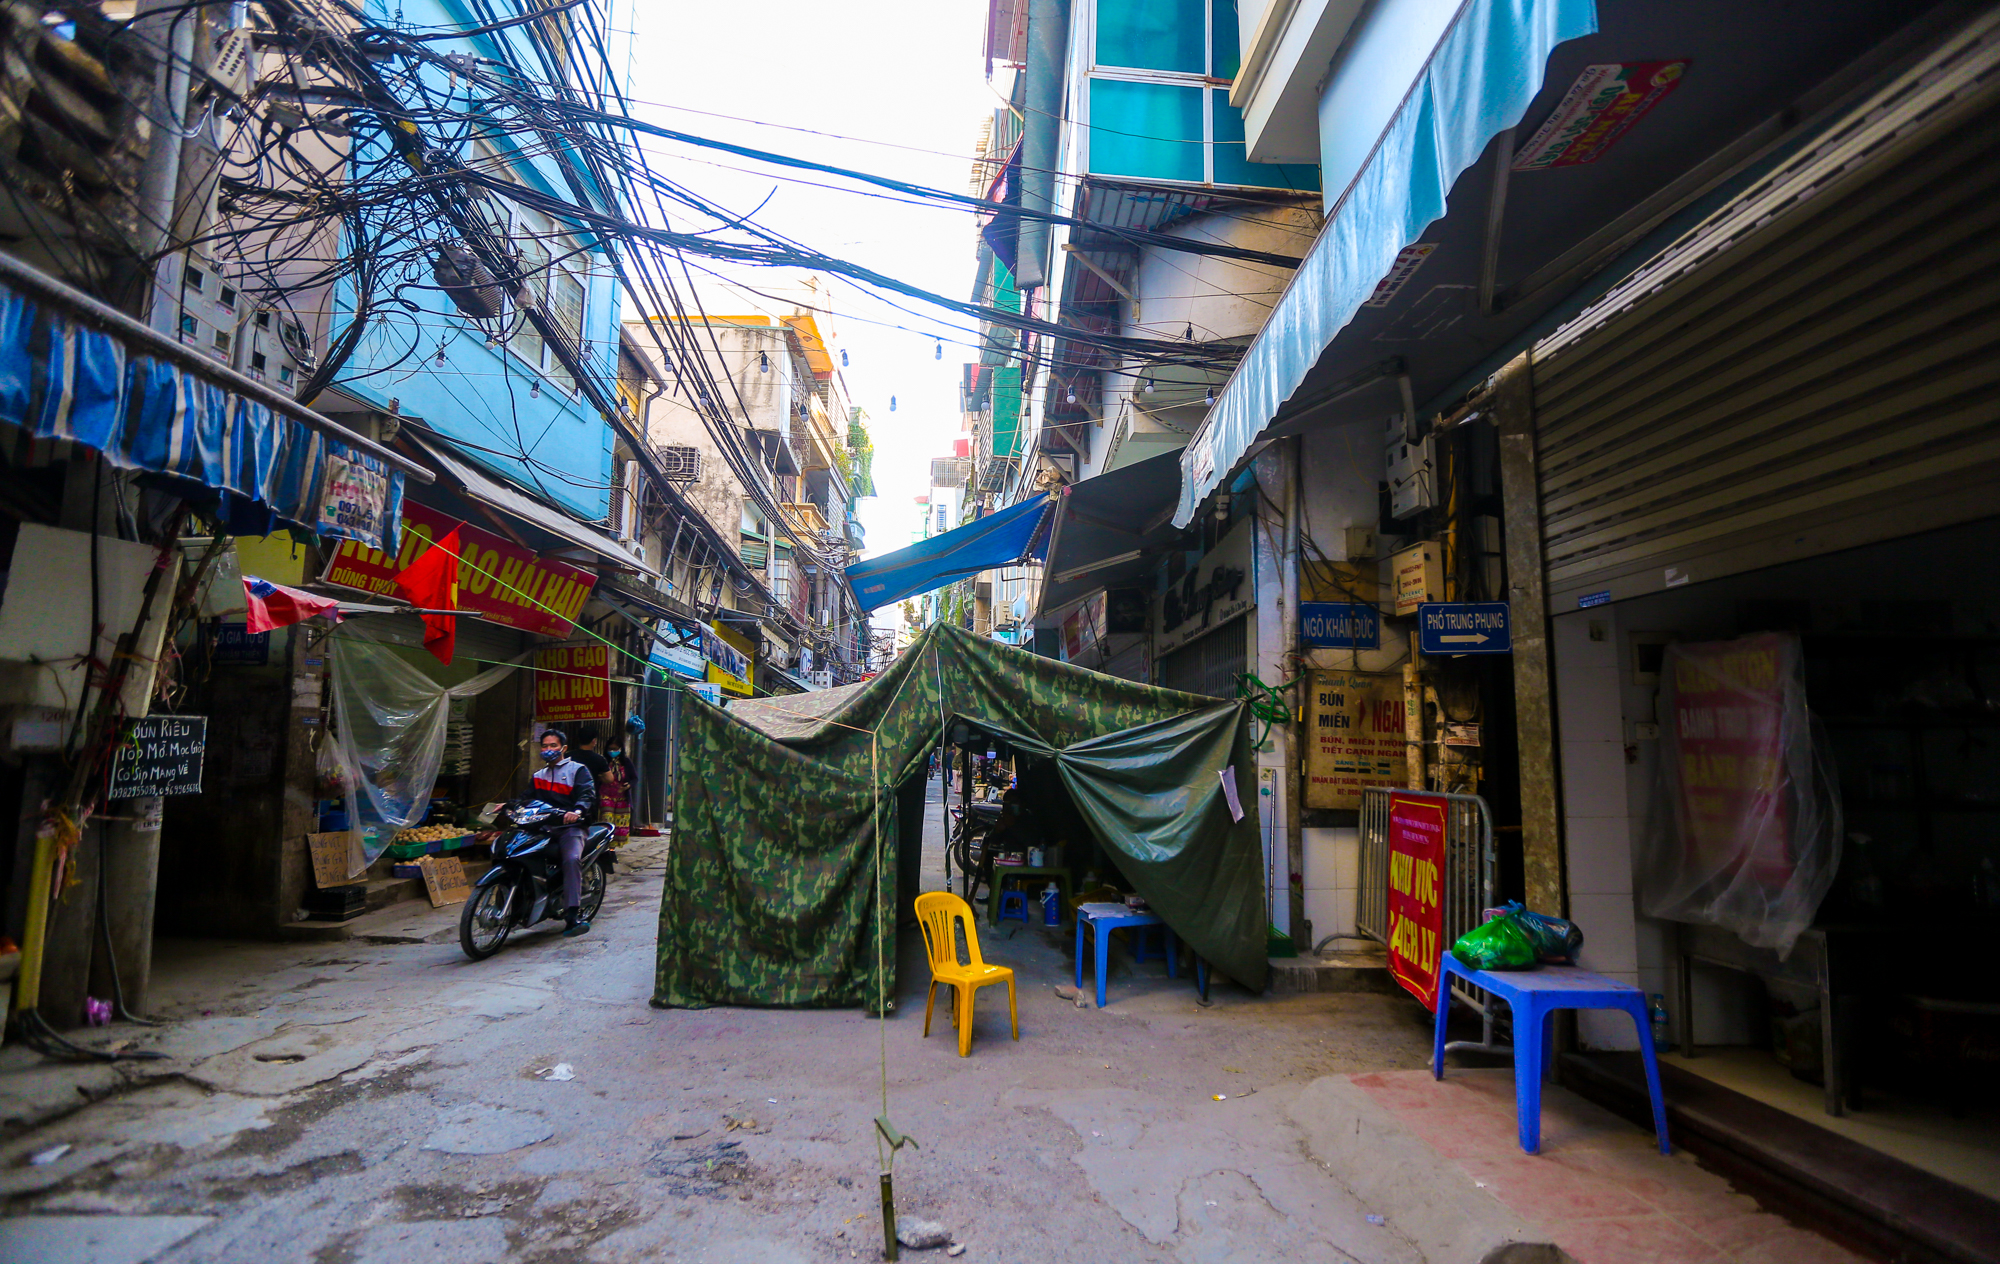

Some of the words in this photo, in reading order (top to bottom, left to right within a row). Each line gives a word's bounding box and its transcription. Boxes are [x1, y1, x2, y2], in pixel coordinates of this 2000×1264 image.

[331, 566, 368, 590] DŨNG
[1303, 613, 1324, 638] NGÕ
[1326, 615, 1352, 639] KHÂM
[1354, 616, 1374, 640] ĐỨC
[1427, 607, 1445, 631] PHỐ
[1446, 613, 1474, 631] TRUNG
[1475, 612, 1504, 633] PHỤNG
[537, 648, 568, 669] KHO
[573, 646, 606, 671] GẠO
[538, 673, 566, 701] HẢI
[571, 673, 604, 702] HẬU
[1320, 690, 1345, 707] BÚN
[160, 719, 190, 738] RIÊU
[1345, 747, 1375, 756] CANH
[1377, 750, 1407, 758] NGAN
[1390, 850, 1414, 897] KHU
[1415, 857, 1438, 914] VỰC
[1420, 926, 1437, 975] LY
